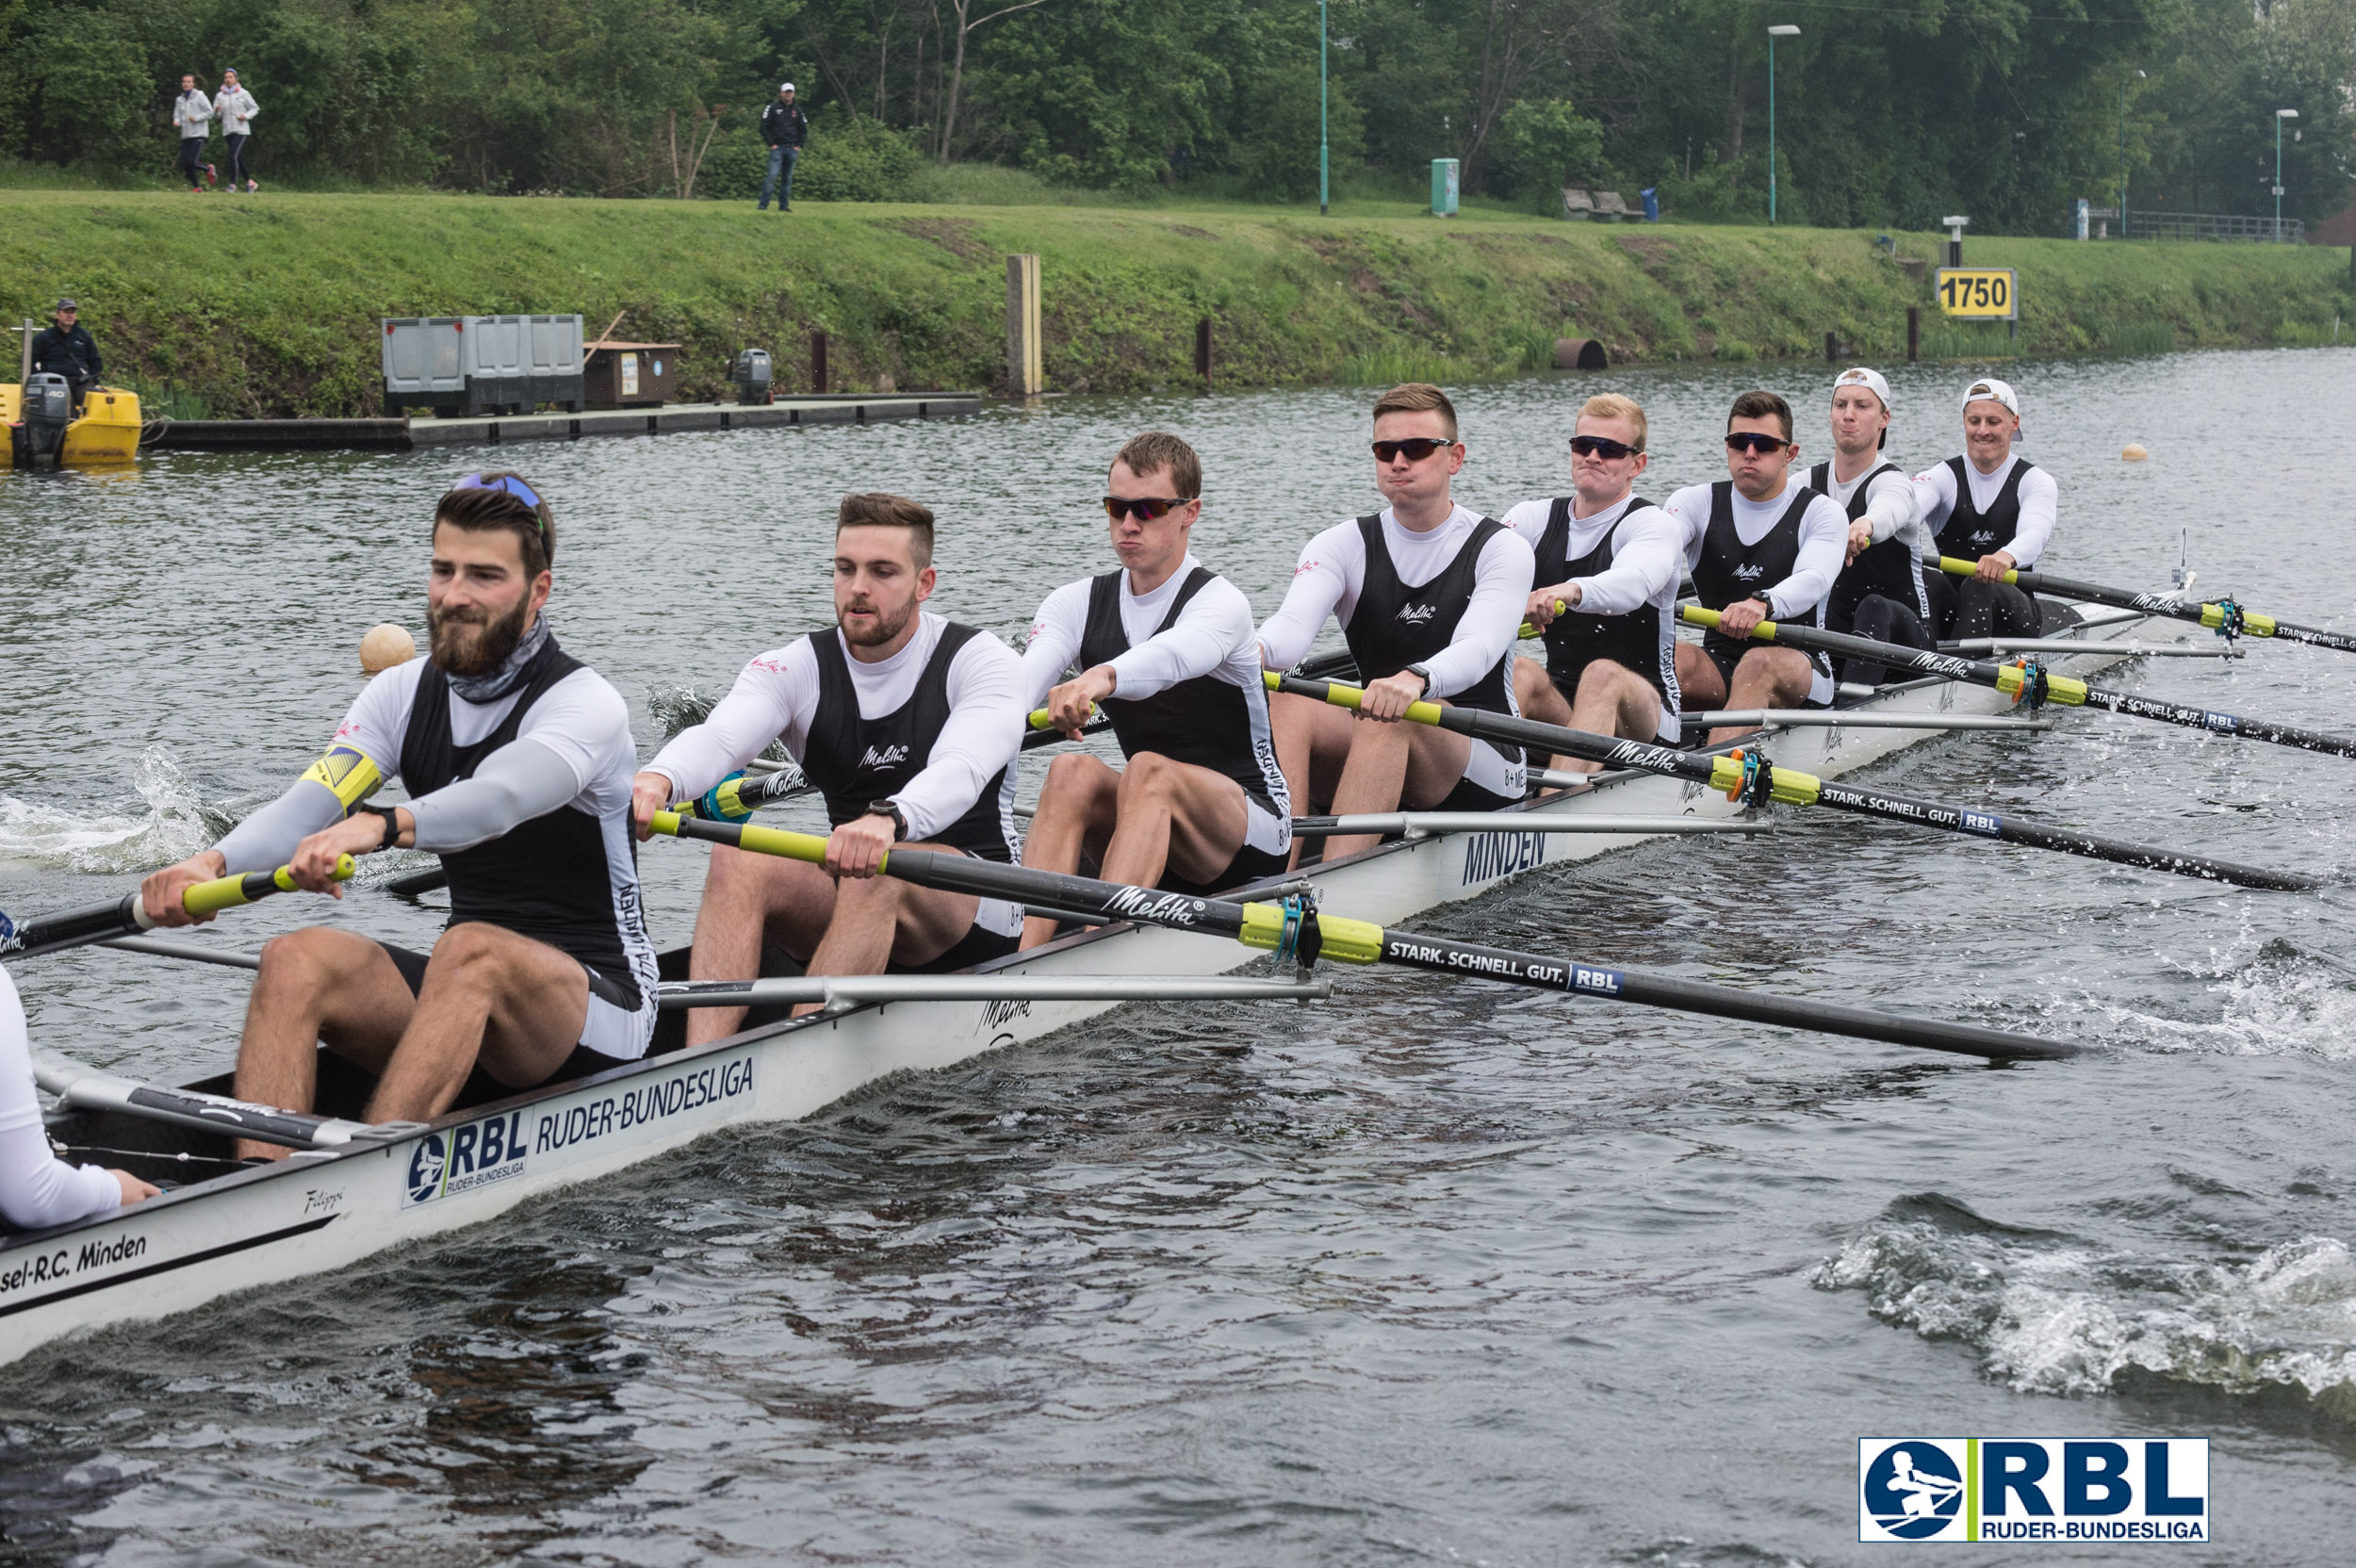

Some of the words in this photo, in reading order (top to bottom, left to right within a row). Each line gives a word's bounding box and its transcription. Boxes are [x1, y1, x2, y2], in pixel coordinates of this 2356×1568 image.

[1939, 277, 2007, 308] 1750
[2207, 712, 2237, 727] RBL
[1824, 788, 1866, 808] STARK.
[1868, 797, 1926, 819] SCHNELL.
[1928, 808, 1956, 825] GUT.
[1965, 814, 1999, 831] RBL
[1462, 831, 1546, 887] MINDEN
[1388, 941, 1445, 965] STARK.
[1448, 951, 1524, 978] SCHNELL.
[1527, 963, 1564, 985] GUT.
[1576, 968, 1620, 990] RBL
[535, 1056, 754, 1155] RUDER-BUNDESLIGA
[449, 1111, 528, 1179] RBL
[446, 1161, 524, 1194] RUDER-BUNDESLIGA
[304, 1186, 346, 1215] Filippi
[77, 1233, 147, 1273] Minden
